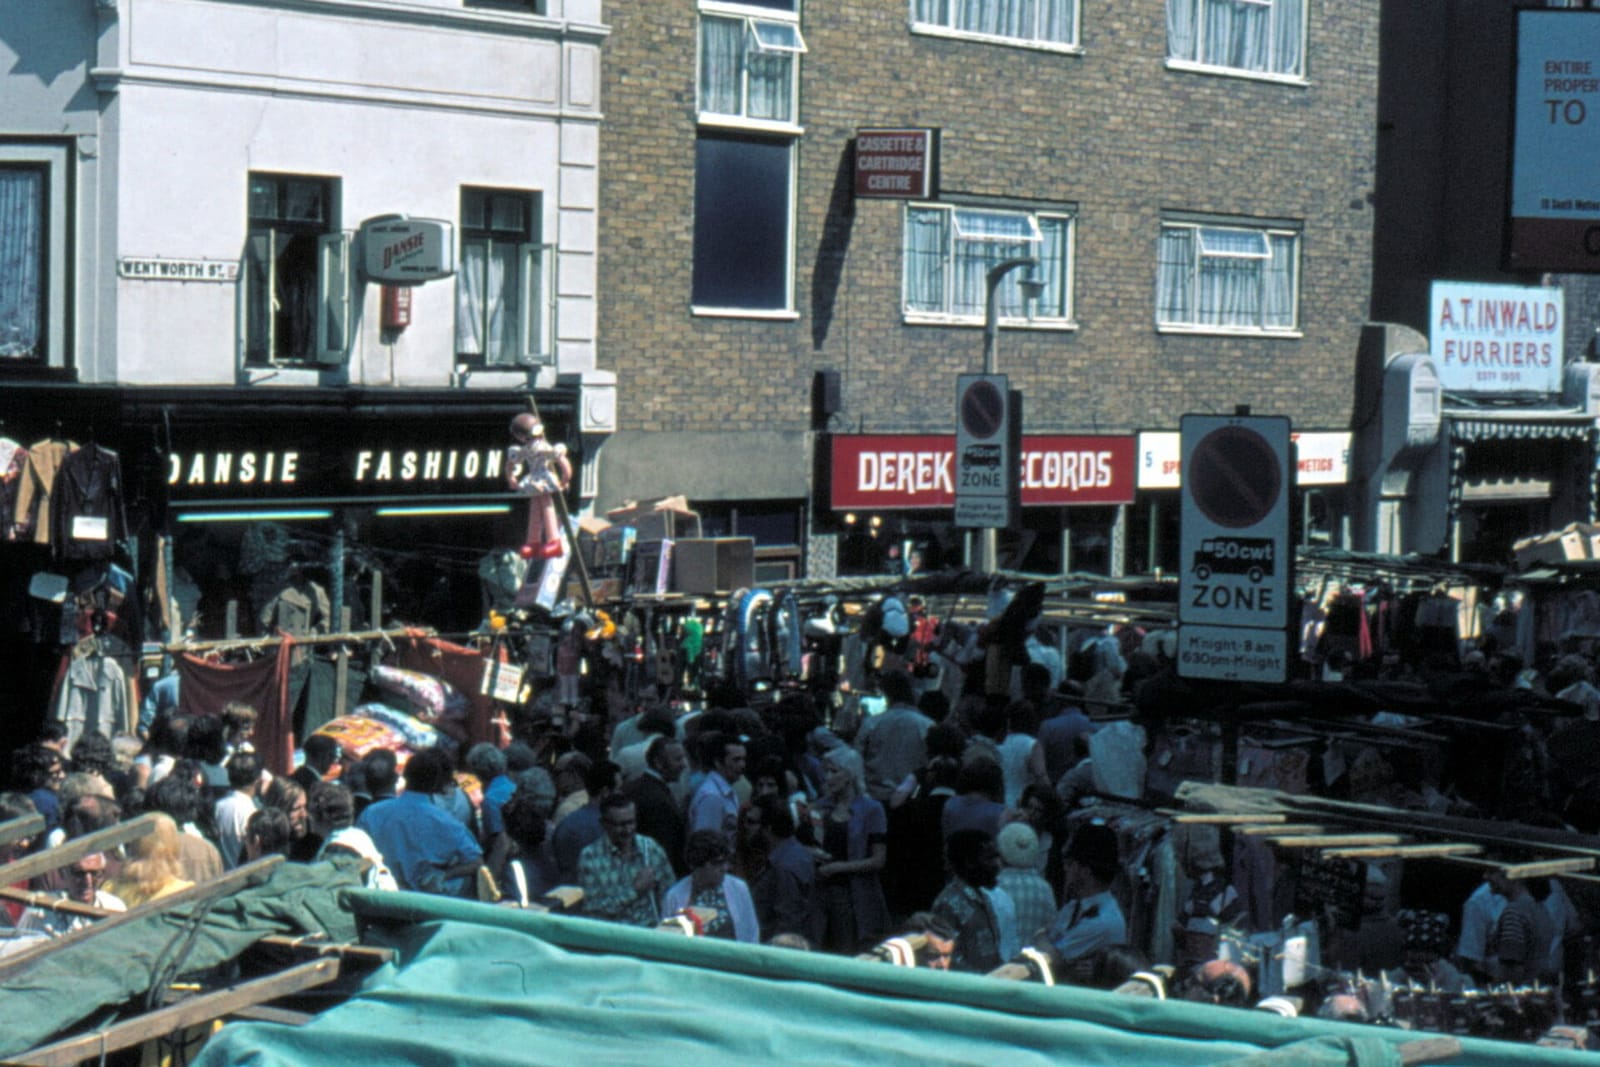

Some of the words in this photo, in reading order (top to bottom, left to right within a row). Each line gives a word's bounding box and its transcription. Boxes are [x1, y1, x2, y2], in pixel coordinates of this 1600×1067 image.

[1545, 61, 1592, 74] ENTIRE
[1545, 78, 1600, 93] PROPER
[1544, 99, 1586, 125] TO
[857, 136, 915, 152] CASSETTE
[858, 155, 922, 171] CARTRIDGE
[868, 175, 911, 190] CENTRE
[123, 261, 204, 276] WENTWORTH
[1445, 340, 1552, 366] FURRIERS
[858, 452, 955, 493] DEREK
[961, 472, 1001, 488] ZONE
[1214, 541, 1273, 560] 50cwt
[1191, 584, 1274, 612] ZONE
